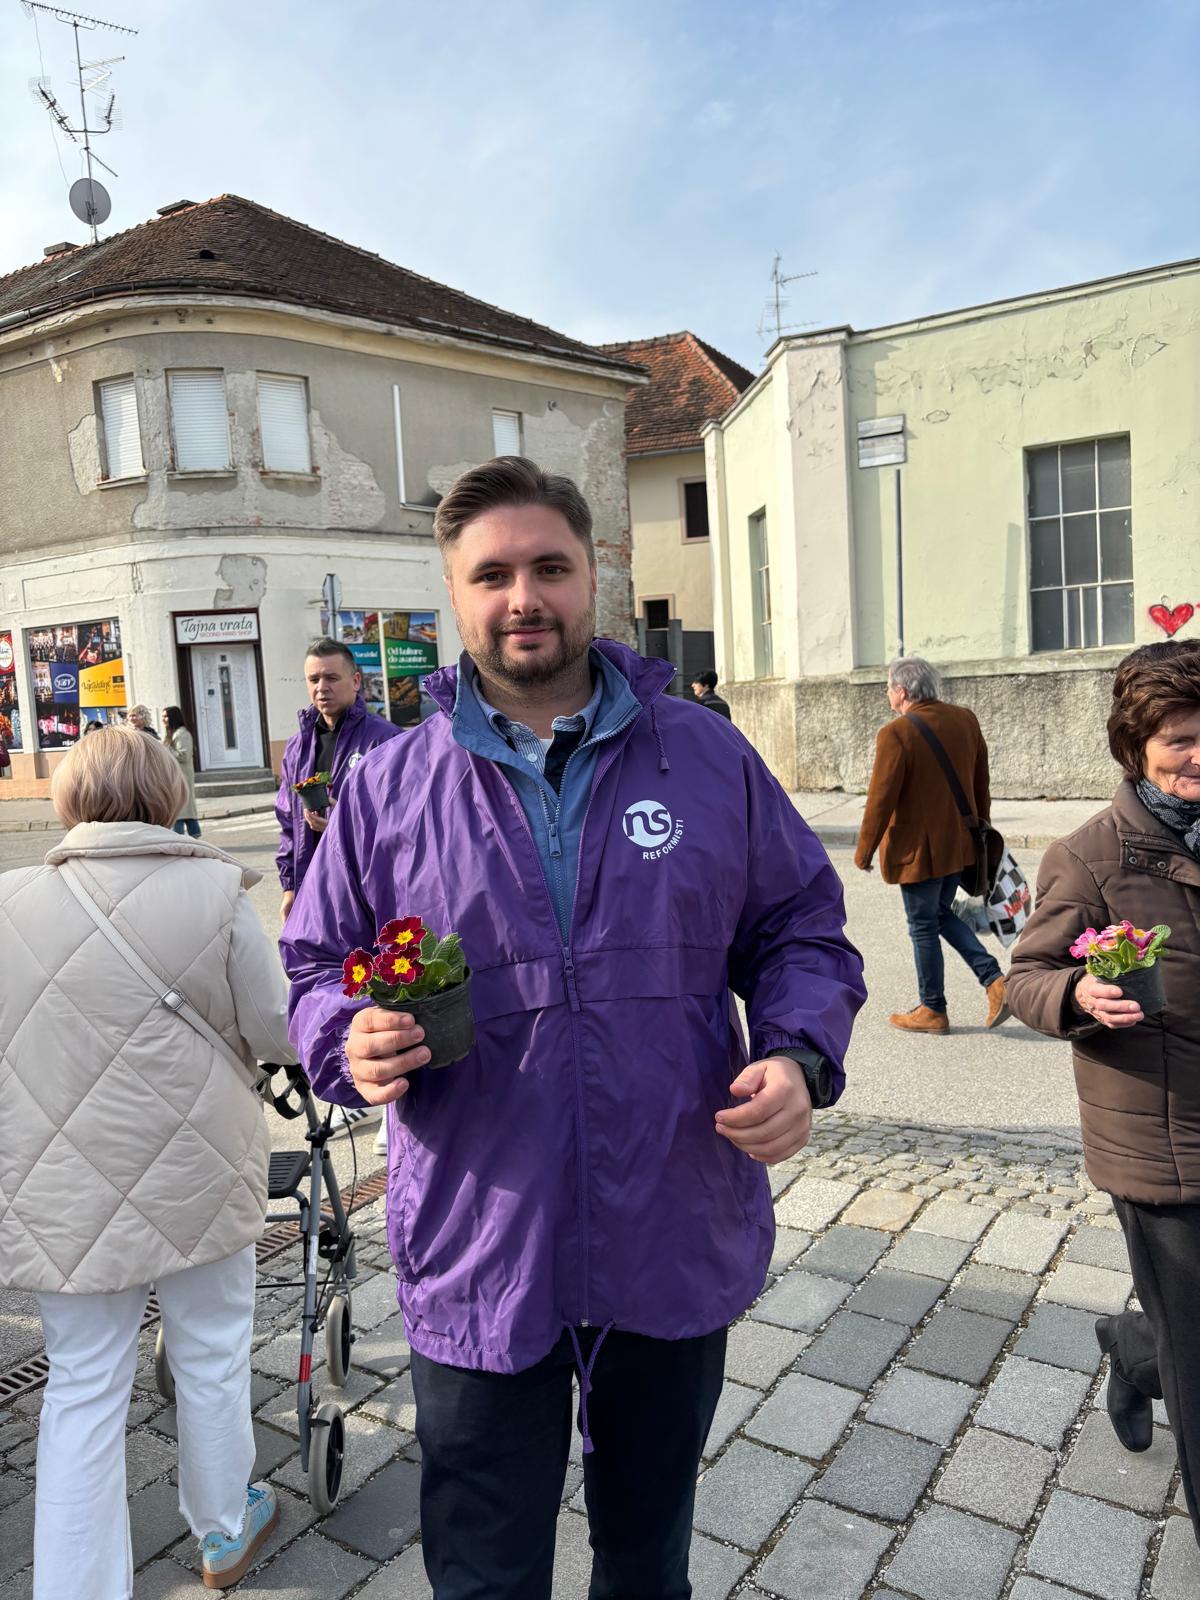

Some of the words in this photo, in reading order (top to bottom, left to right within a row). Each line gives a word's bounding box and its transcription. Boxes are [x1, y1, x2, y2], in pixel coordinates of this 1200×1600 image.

[180, 618, 216, 641] Tajna
[220, 616, 253, 631] vrata
[642, 819, 684, 860] REFORMISTI
